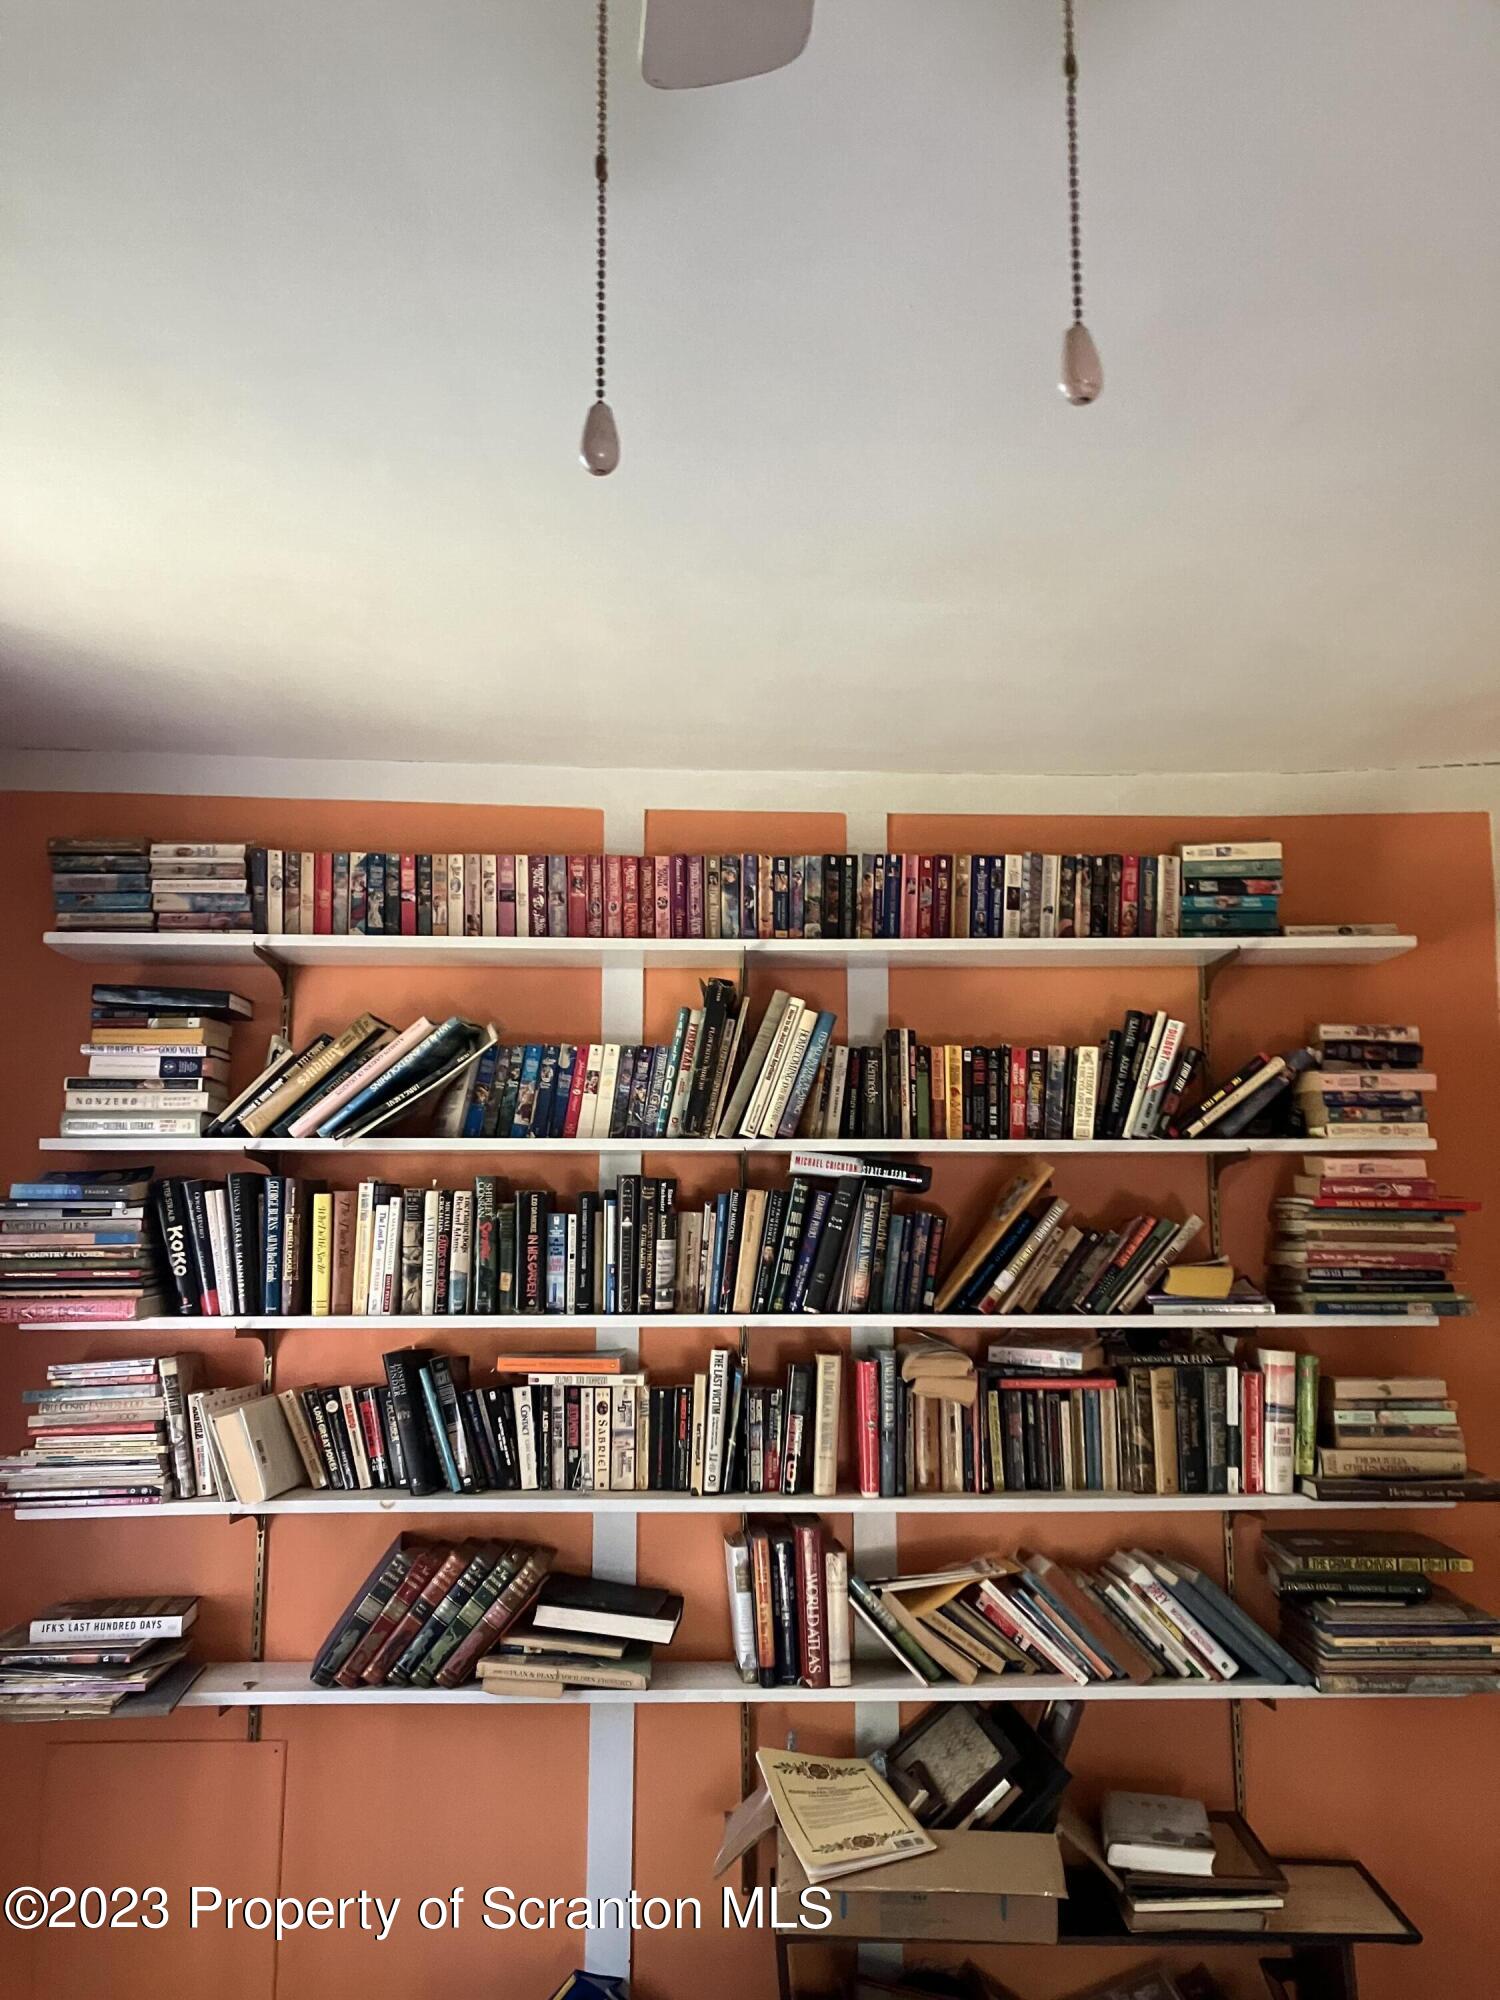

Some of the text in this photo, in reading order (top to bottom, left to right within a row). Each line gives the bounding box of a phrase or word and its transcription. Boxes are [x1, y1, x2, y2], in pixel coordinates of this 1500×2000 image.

[862, 1060, 878, 1104] Kennedys
[76, 1097, 138, 1105] NONZERO
[795, 1156, 857, 1173] MICHAEL CRICHTON
[268, 1181, 278, 1230] GEORGE BURNS
[485, 1183, 493, 1216] SHIRLEY
[234, 1215, 242, 1247] HARRIS
[268, 1234, 277, 1243] All
[527, 1234, 538, 1245] IN
[167, 1225, 187, 1277] KOKO
[267, 1252, 276, 1263] Best
[527, 1246, 538, 1261] HIS
[266, 1264, 276, 1282] Friends
[396, 1363, 406, 1395] JOSEPH
[712, 1354, 724, 1414] THE LAST VICTIM
[520, 1404, 531, 1436] CONTACT
[318, 1424, 331, 1448] GREAT
[597, 1419, 608, 1472] SABRIEL
[324, 1449, 337, 1472] JOKES
[42, 1620, 162, 1633] JFK'S LAST HUNDRED DAYS
[806, 1572, 821, 1673] WORLD ATLAS
